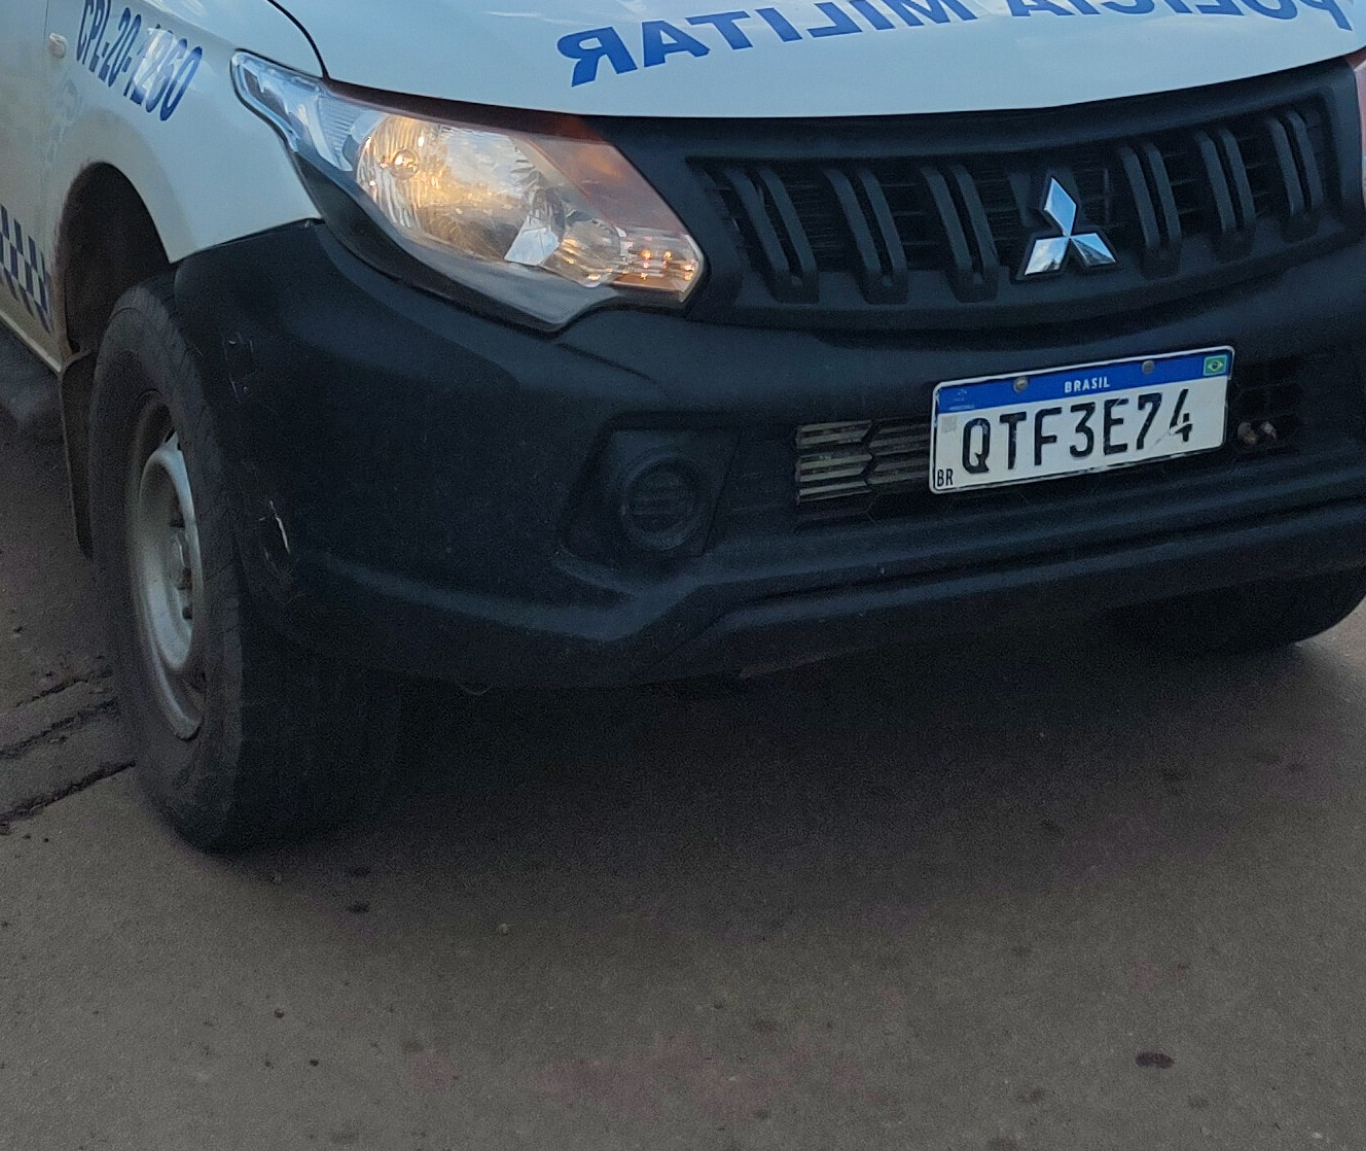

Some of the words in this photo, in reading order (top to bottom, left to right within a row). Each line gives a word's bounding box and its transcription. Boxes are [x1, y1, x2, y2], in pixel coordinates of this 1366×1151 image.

[1064, 376, 1111, 393] BRASIL
[961, 388, 1193, 475] QTF3E74
[936, 468, 954, 487] BR
